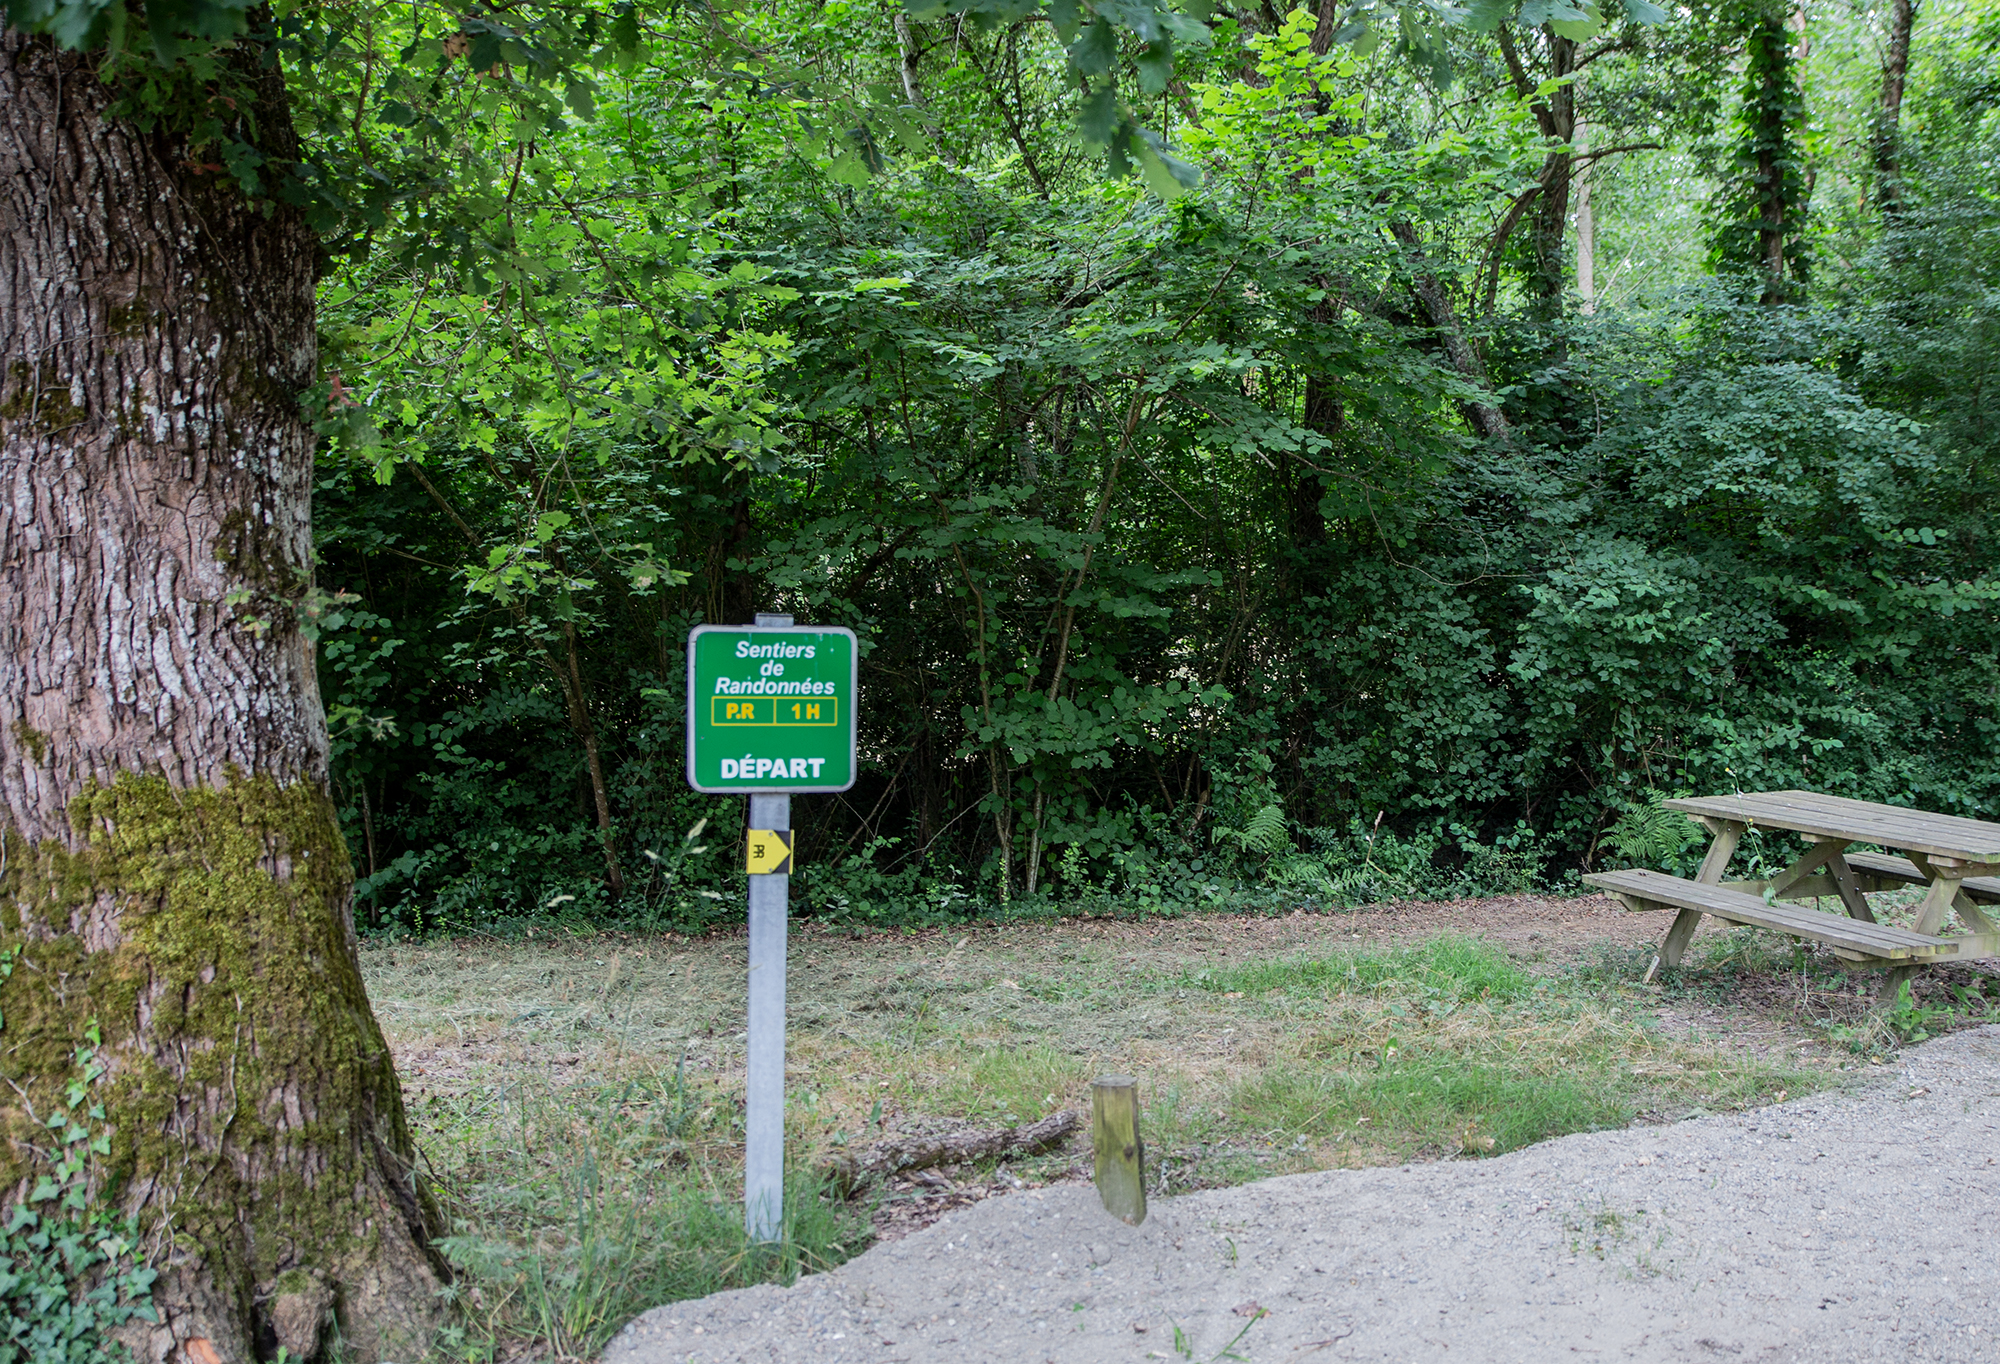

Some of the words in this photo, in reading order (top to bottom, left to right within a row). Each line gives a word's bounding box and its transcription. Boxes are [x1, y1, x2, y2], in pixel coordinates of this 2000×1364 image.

[735, 641, 816, 659] Sentiers
[760, 660, 784, 677] de
[714, 677, 835, 695] Randonnées
[726, 703, 755, 719] P.R
[791, 703, 801, 719] 1
[806, 703, 820, 719] H
[721, 754, 825, 779] DÉPART
[753, 844, 765, 859] PR
